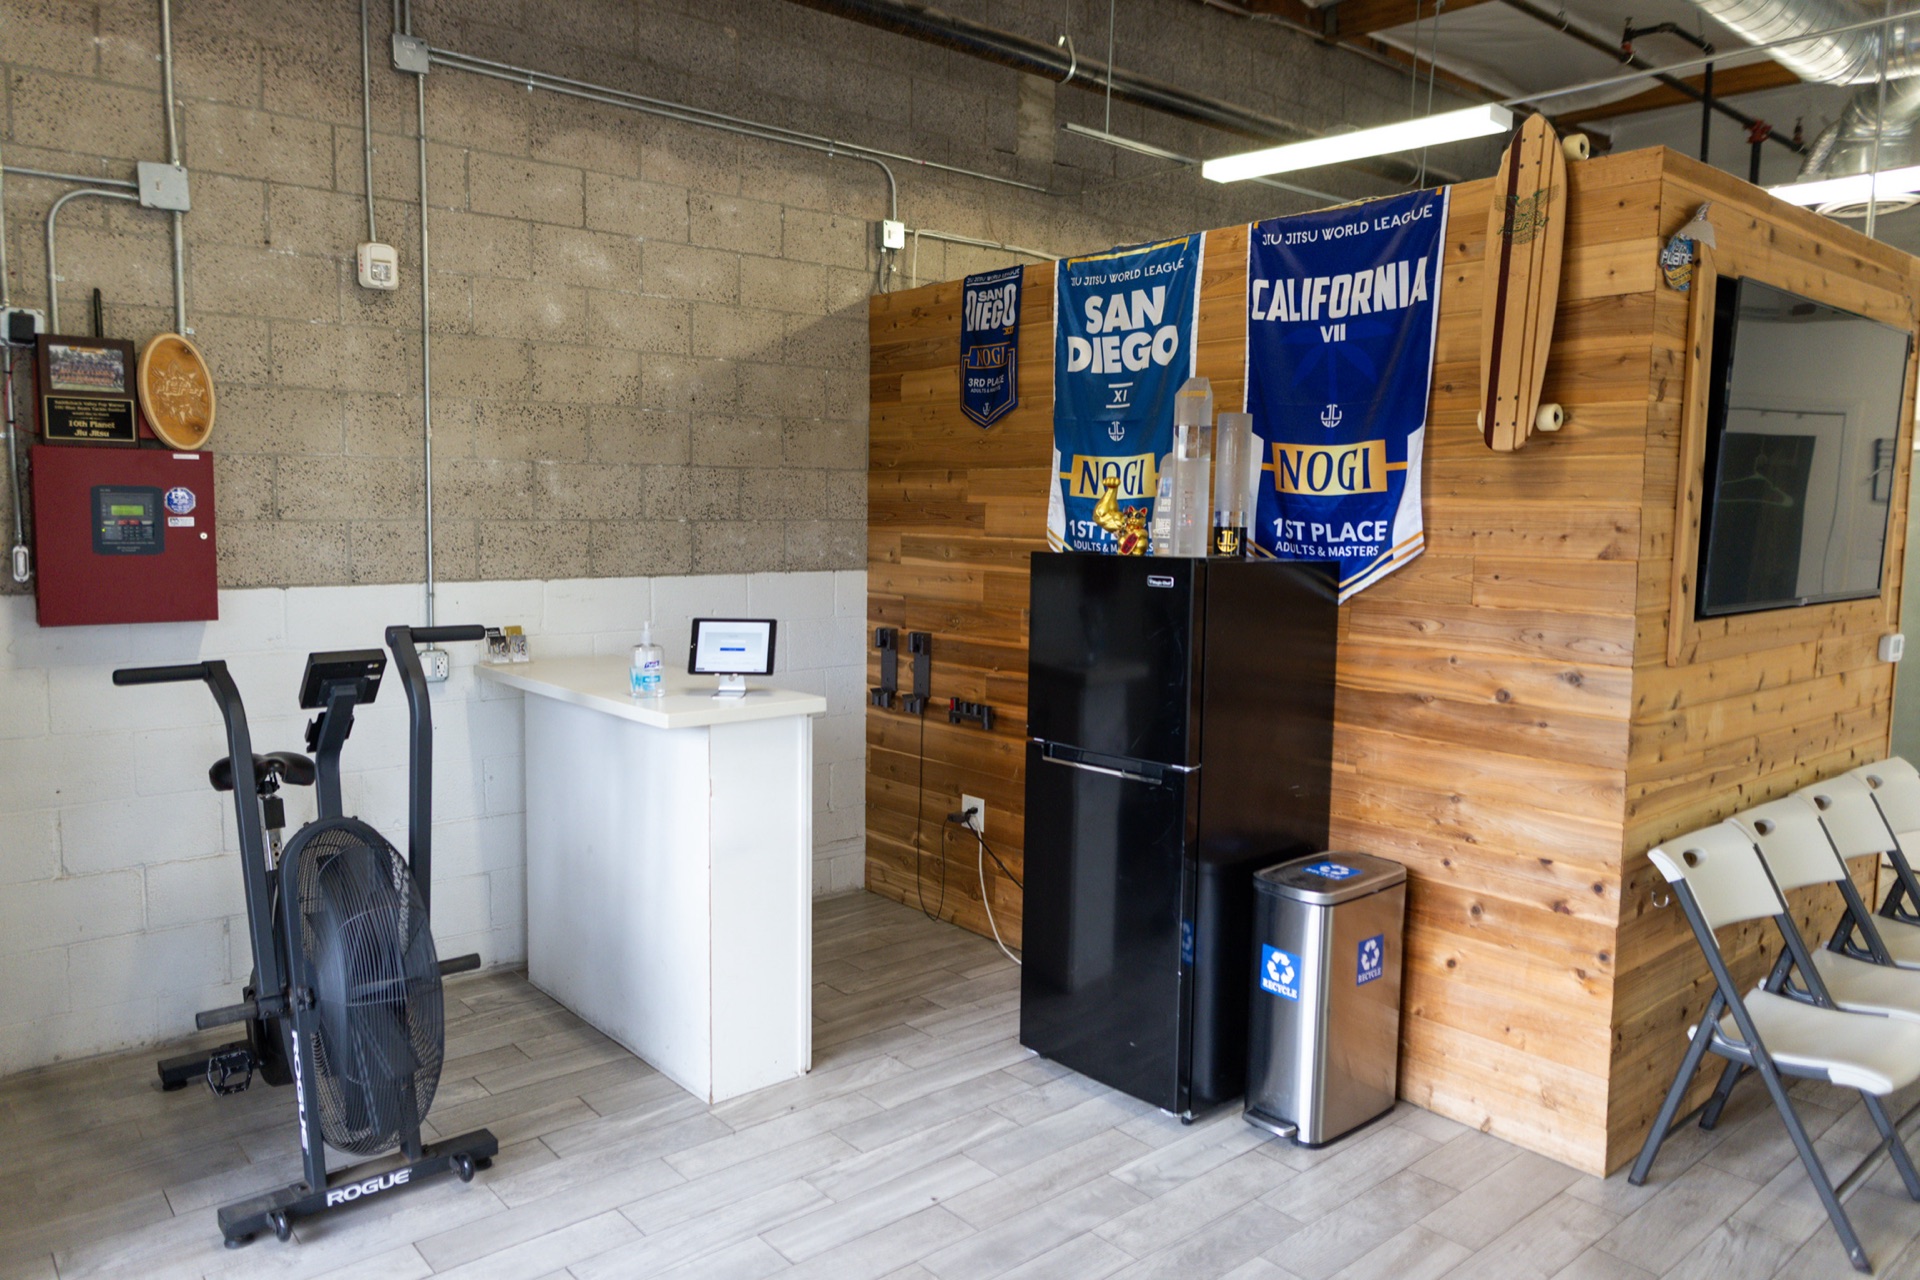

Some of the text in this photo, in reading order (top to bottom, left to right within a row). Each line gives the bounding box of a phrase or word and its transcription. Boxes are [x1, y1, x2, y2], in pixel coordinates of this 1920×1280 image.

[1262, 204, 1433, 246] JIU JITSU WORLD LEAGUE
[1070, 258, 1184, 286] JIU JITSU WORLD LEAGUE
[978, 288, 1003, 302] SAN
[1251, 256, 1428, 322] CALIFORNIA
[965, 283, 1017, 332] DIEGO
[1084, 285, 1166, 334] SAN
[1320, 323, 1346, 343] VII
[976, 346, 1005, 367] NOGI
[1067, 324, 1179, 374] DIEGO
[968, 374, 1004, 387] 3RD PLACE
[1113, 390, 1127, 403] XI
[68, 420, 115, 429] 10th Planet
[74, 429, 110, 438] Jiu Jitsu
[1079, 459, 1145, 496] NOGI
[1279, 447, 1372, 492] NOGI
[1069, 520, 1097, 539] 1ST
[1273, 518, 1388, 543] 1ST PLACE
[1074, 540, 1101, 551] ADULTS
[1102, 543, 1109, 553] &
[1275, 541, 1379, 557] ADULTS & MASTERS
[1357, 967, 1382, 983] RECYCLE
[1262, 978, 1298, 1000] RECYCLE
[292, 1030, 309, 1156] ROGUE
[327, 1168, 410, 1207] ROGUE
